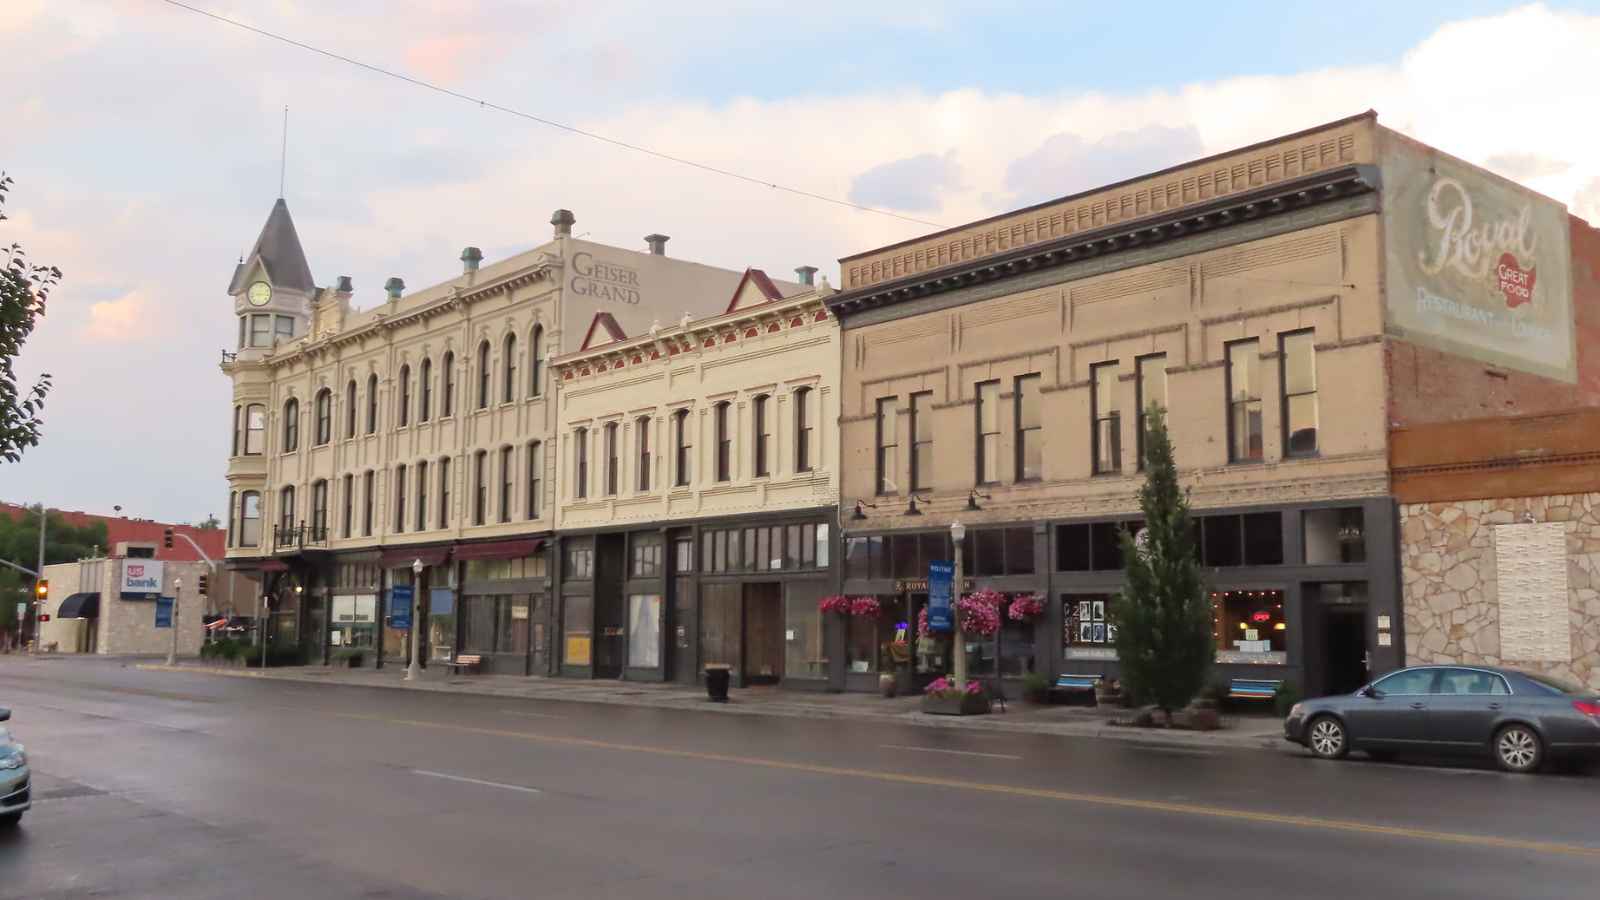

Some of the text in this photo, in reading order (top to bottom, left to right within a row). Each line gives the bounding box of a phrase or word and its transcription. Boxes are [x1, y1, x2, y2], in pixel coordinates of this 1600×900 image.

[1418, 178, 1536, 278] Royal
[572, 252, 640, 287] GEISER
[1499, 264, 1529, 288] GREAT
[571, 276, 640, 304] GRAND
[1500, 280, 1529, 298] FOOD
[127, 577, 157, 588] bank
